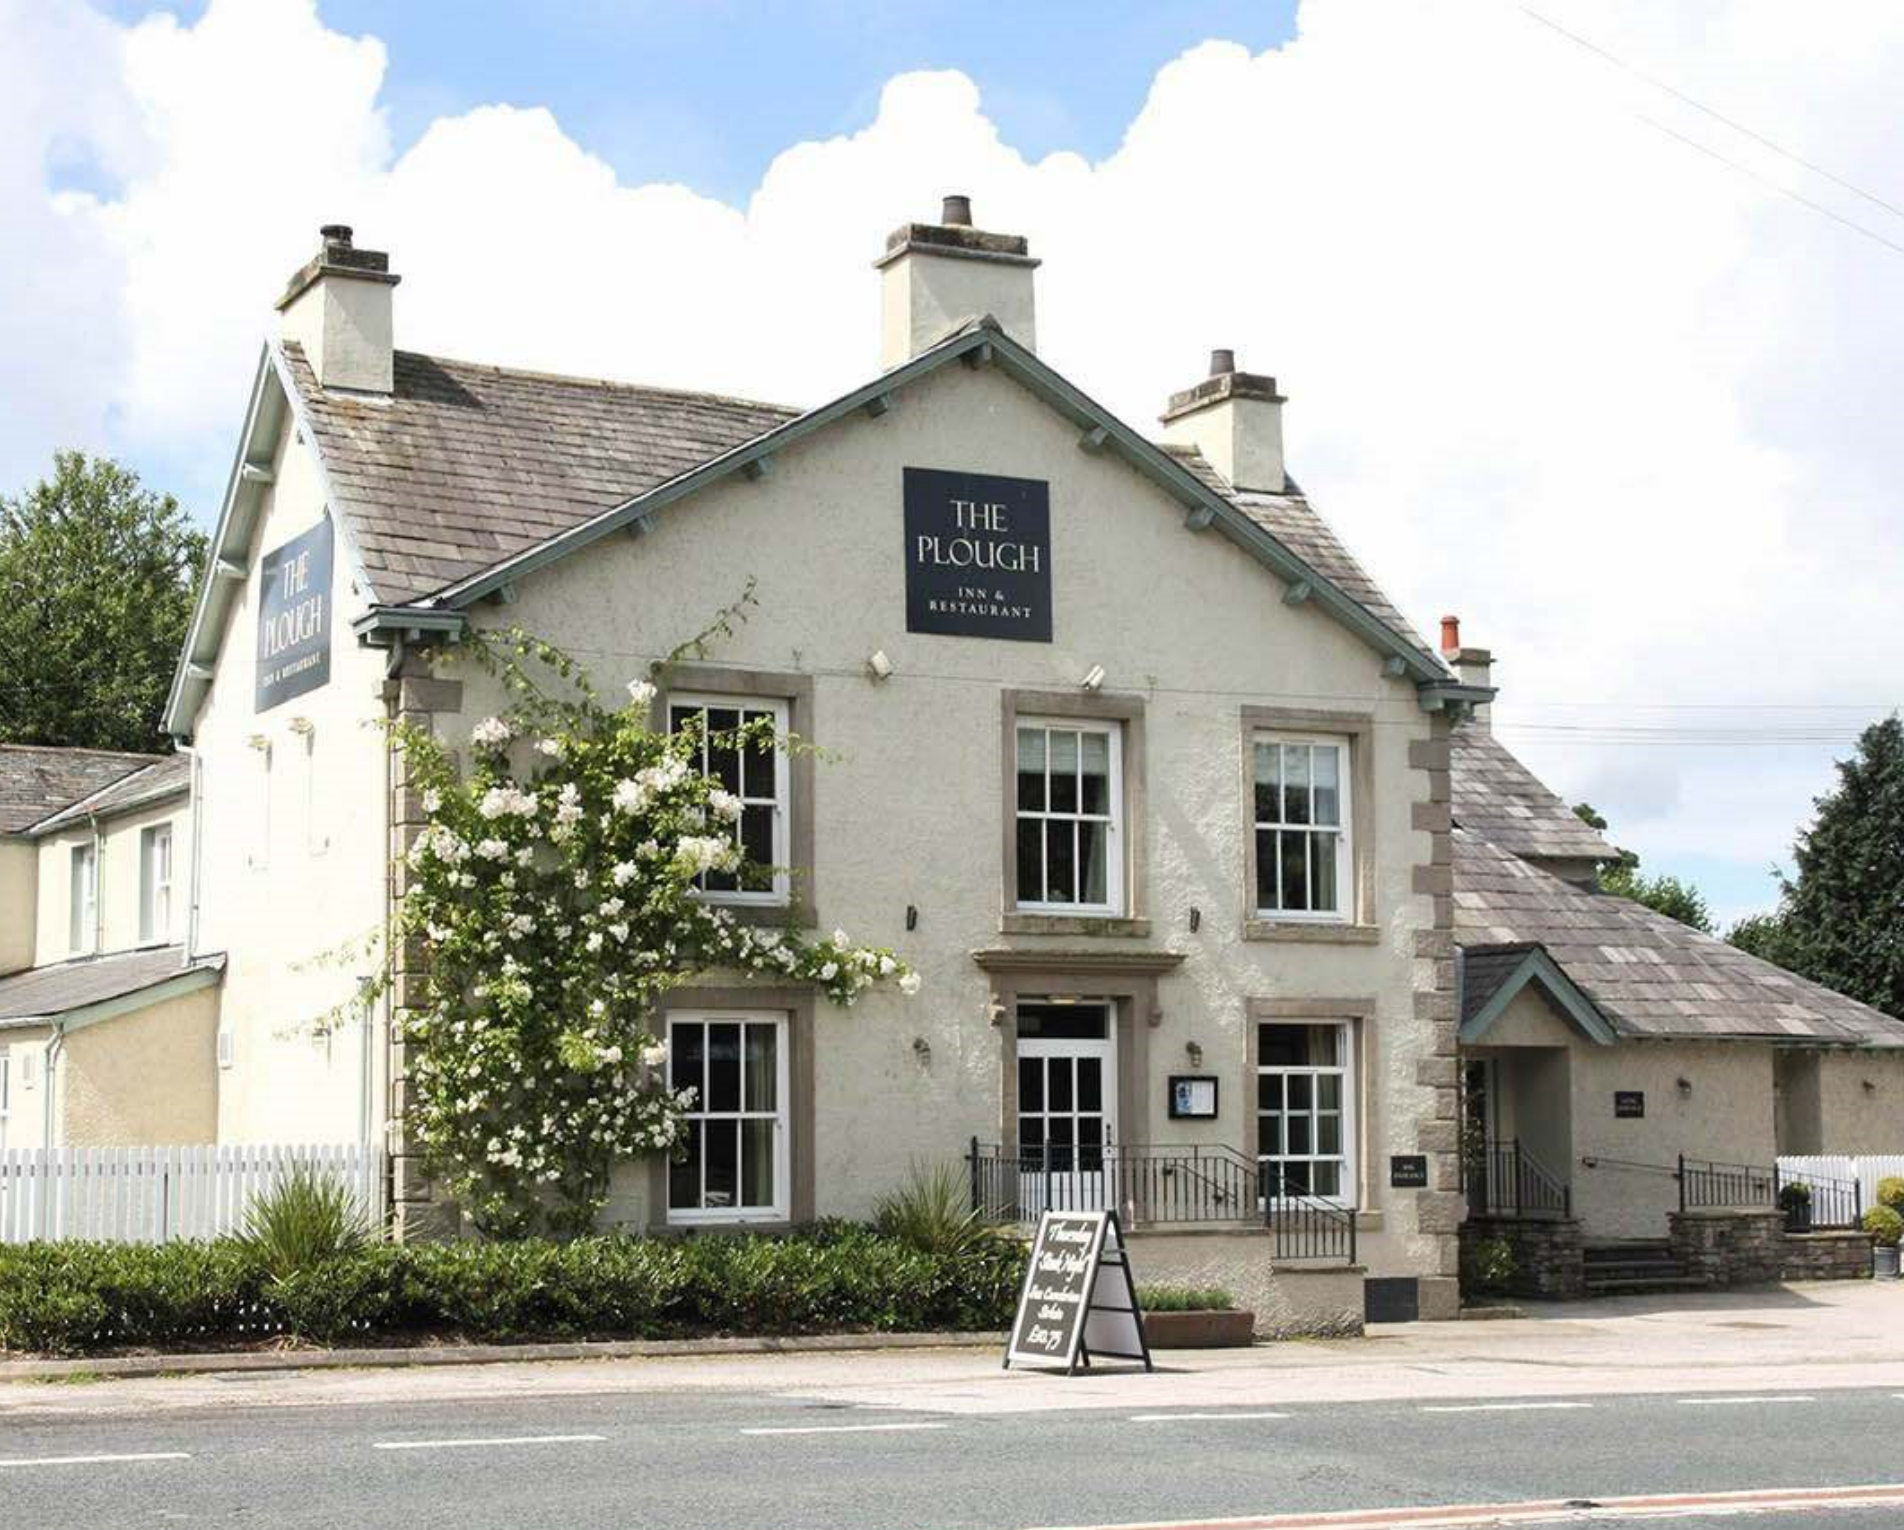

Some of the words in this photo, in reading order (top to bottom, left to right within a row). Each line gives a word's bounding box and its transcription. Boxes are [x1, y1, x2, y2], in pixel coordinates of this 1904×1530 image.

[950, 499, 1008, 532] THE
[917, 536, 1040, 573] PLOUGH
[283, 549, 311, 601] THE
[930, 600, 1032, 619] RESTAURANT
[958, 587, 987, 600] INN
[994, 589, 1004, 601] &
[264, 594, 323, 659] PLOUGH
